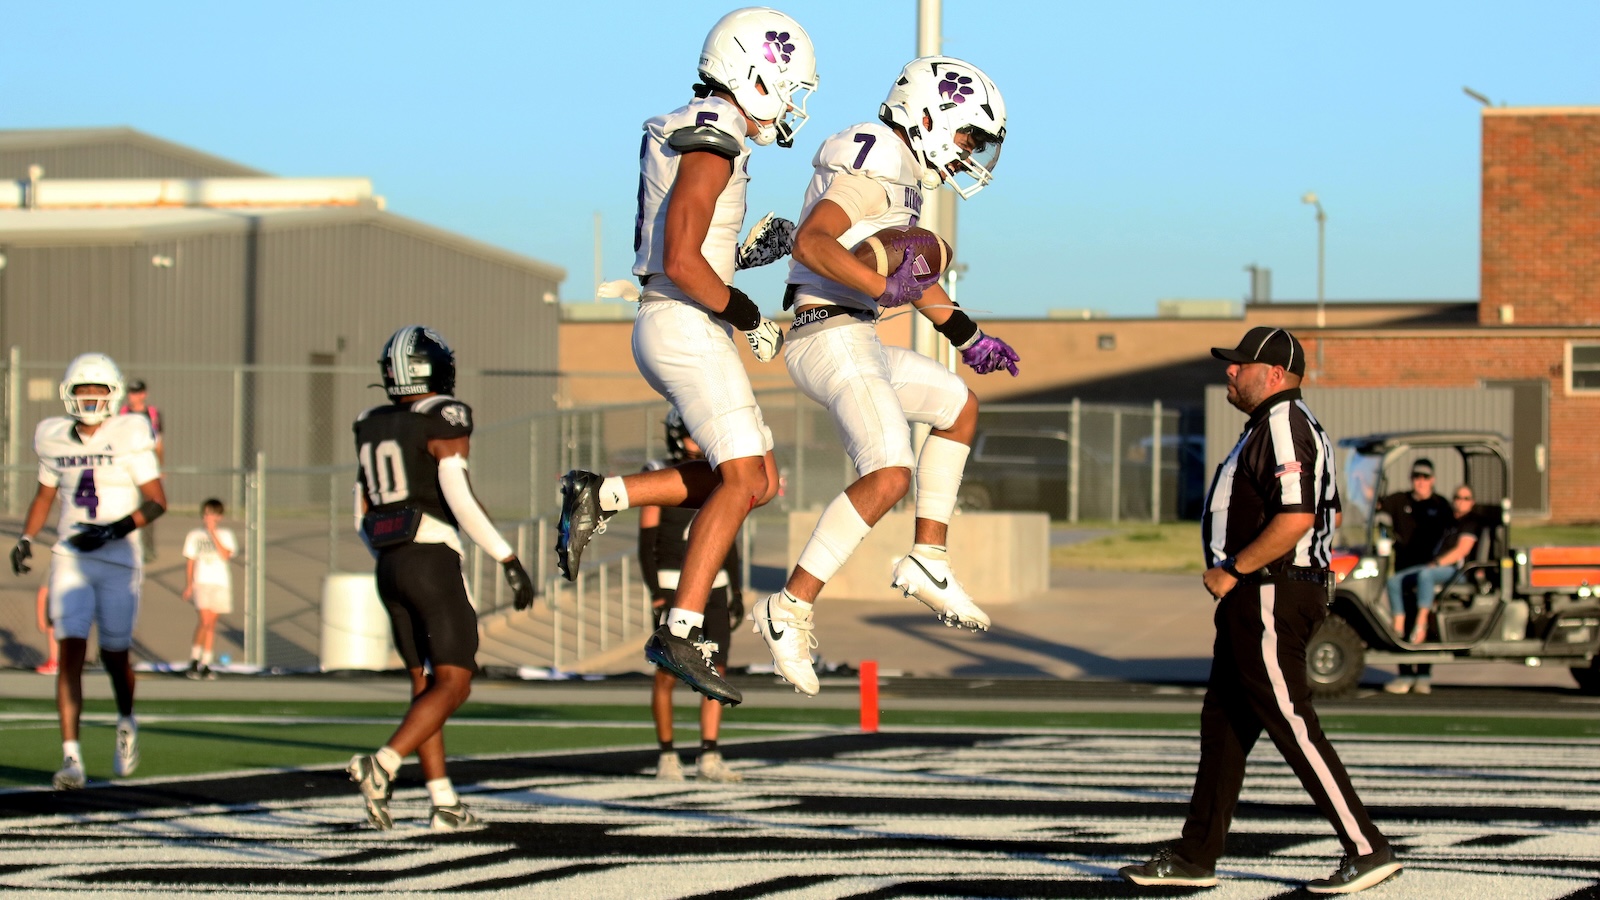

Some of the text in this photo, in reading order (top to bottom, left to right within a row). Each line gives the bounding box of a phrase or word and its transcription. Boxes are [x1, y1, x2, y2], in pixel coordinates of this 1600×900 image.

[853, 133, 876, 169] 7
[74, 469, 98, 518] 4
[360, 440, 408, 505] 10
